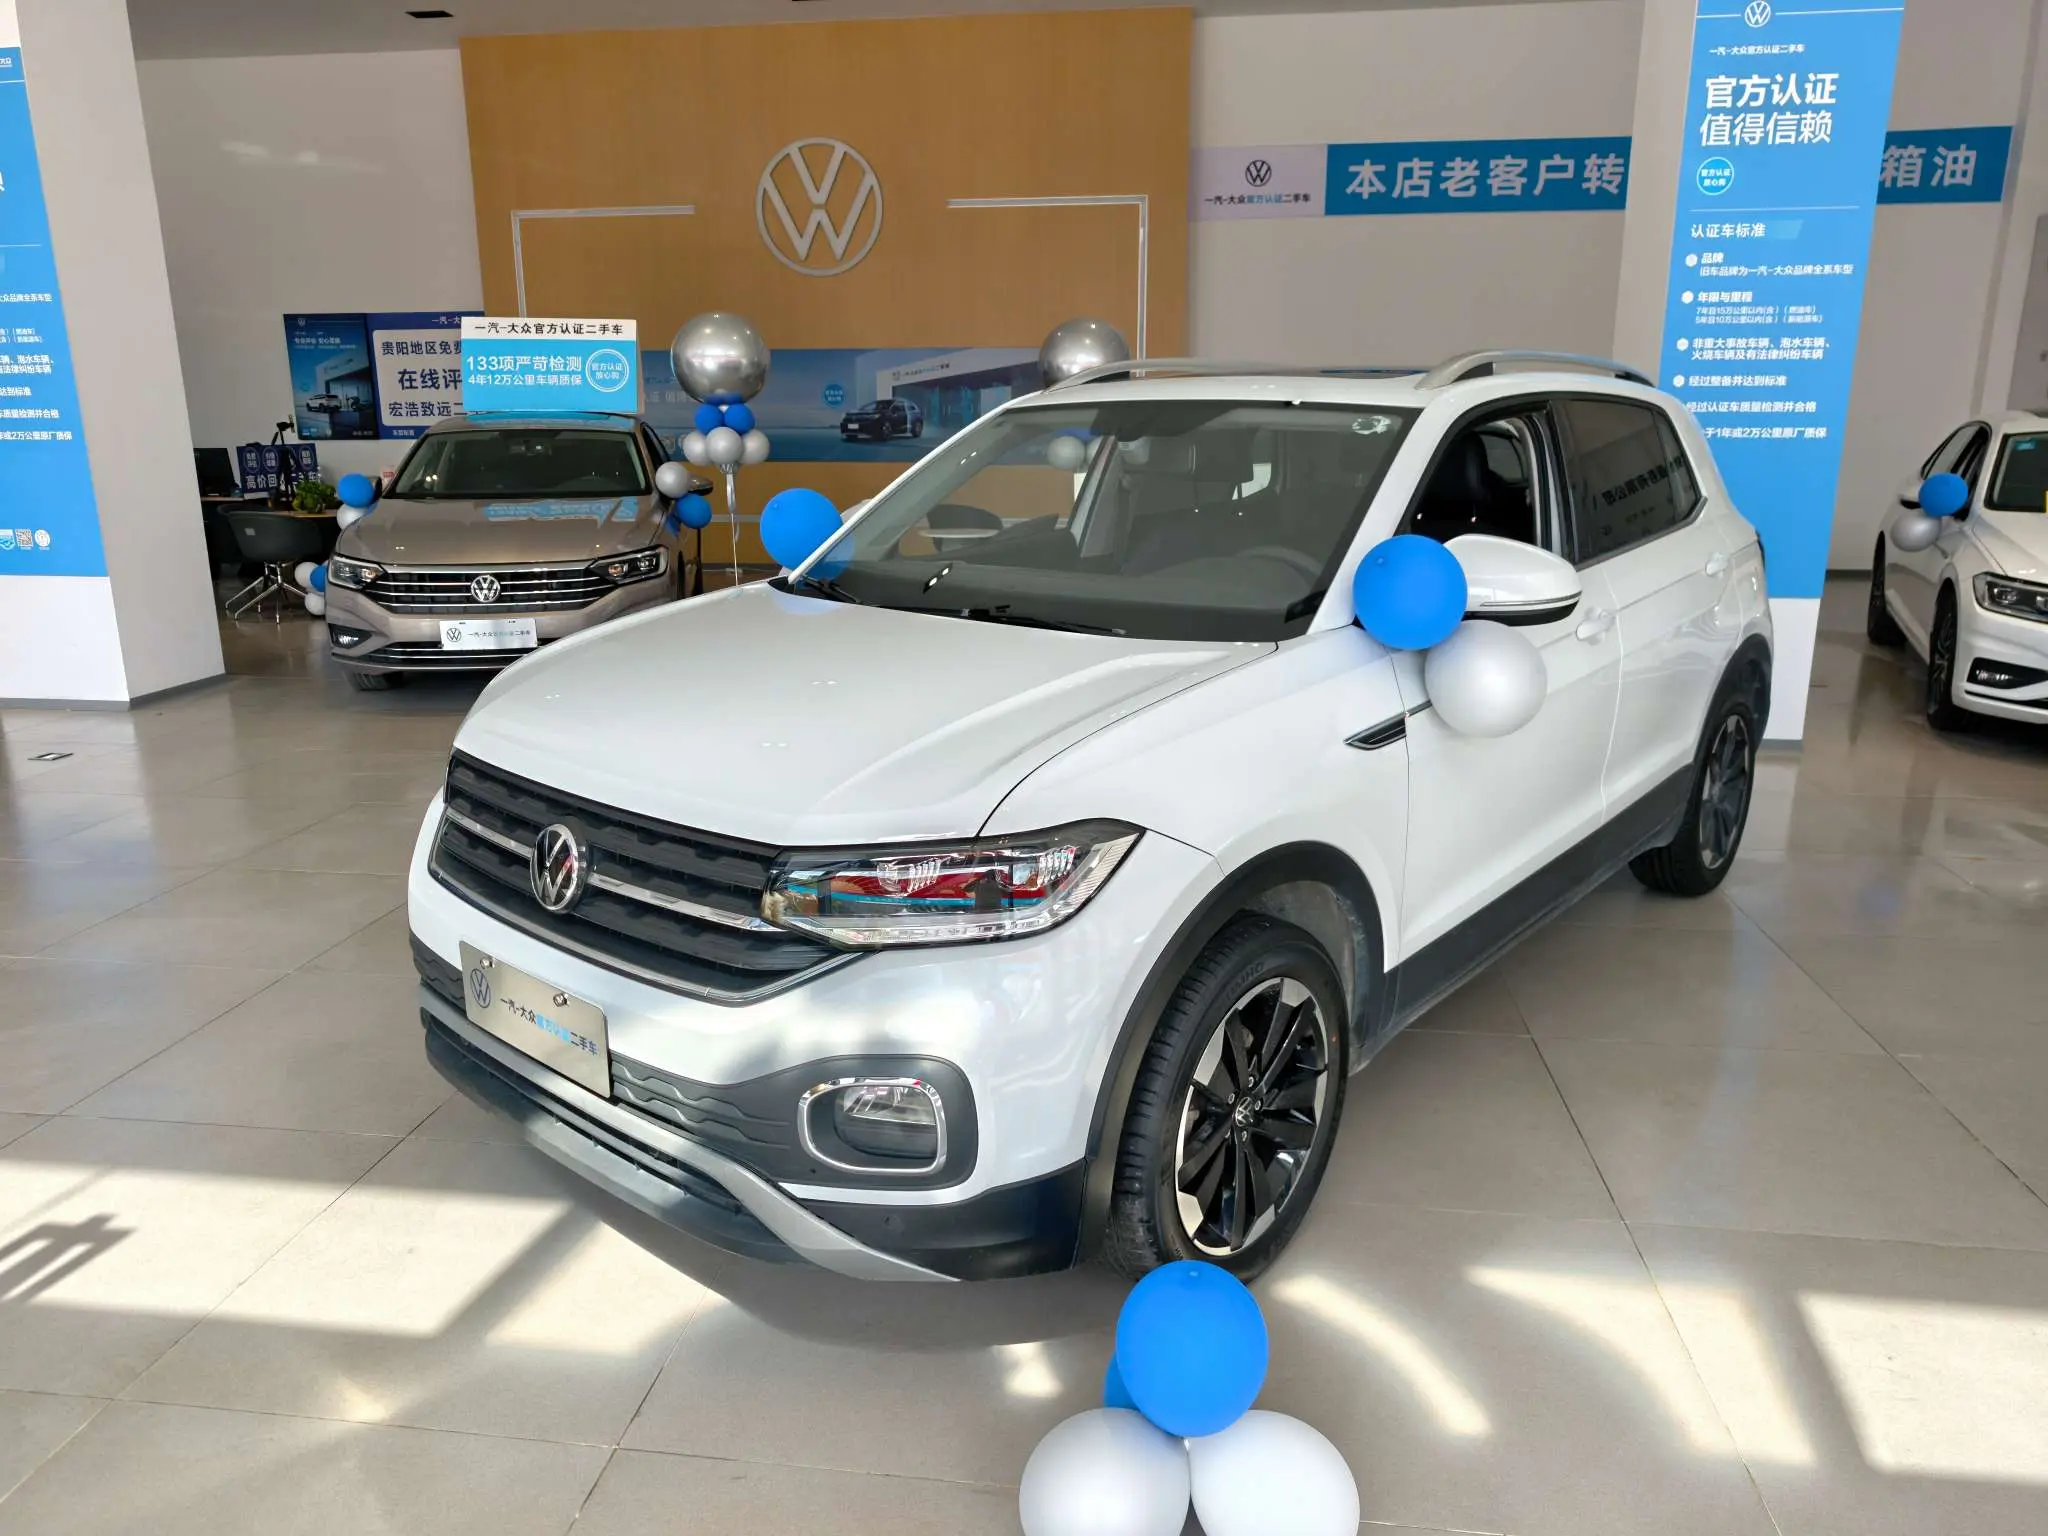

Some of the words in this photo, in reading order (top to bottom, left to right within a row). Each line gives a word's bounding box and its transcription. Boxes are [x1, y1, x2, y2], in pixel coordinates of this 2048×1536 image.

[1705, 73, 1840, 109] 官方认证
[1700, 110, 1833, 147] 值得信赖
[1345, 153, 1626, 200] 本店老客户转
[1879, 144, 1977, 188] 箱油
[1690, 222, 1767, 239] 认证车标准
[1701, 252, 1724, 264] 品牌
[467, 355, 582, 372] 133项严苛检测
[468, 374, 583, 386] 4年12万公里车辆质保
